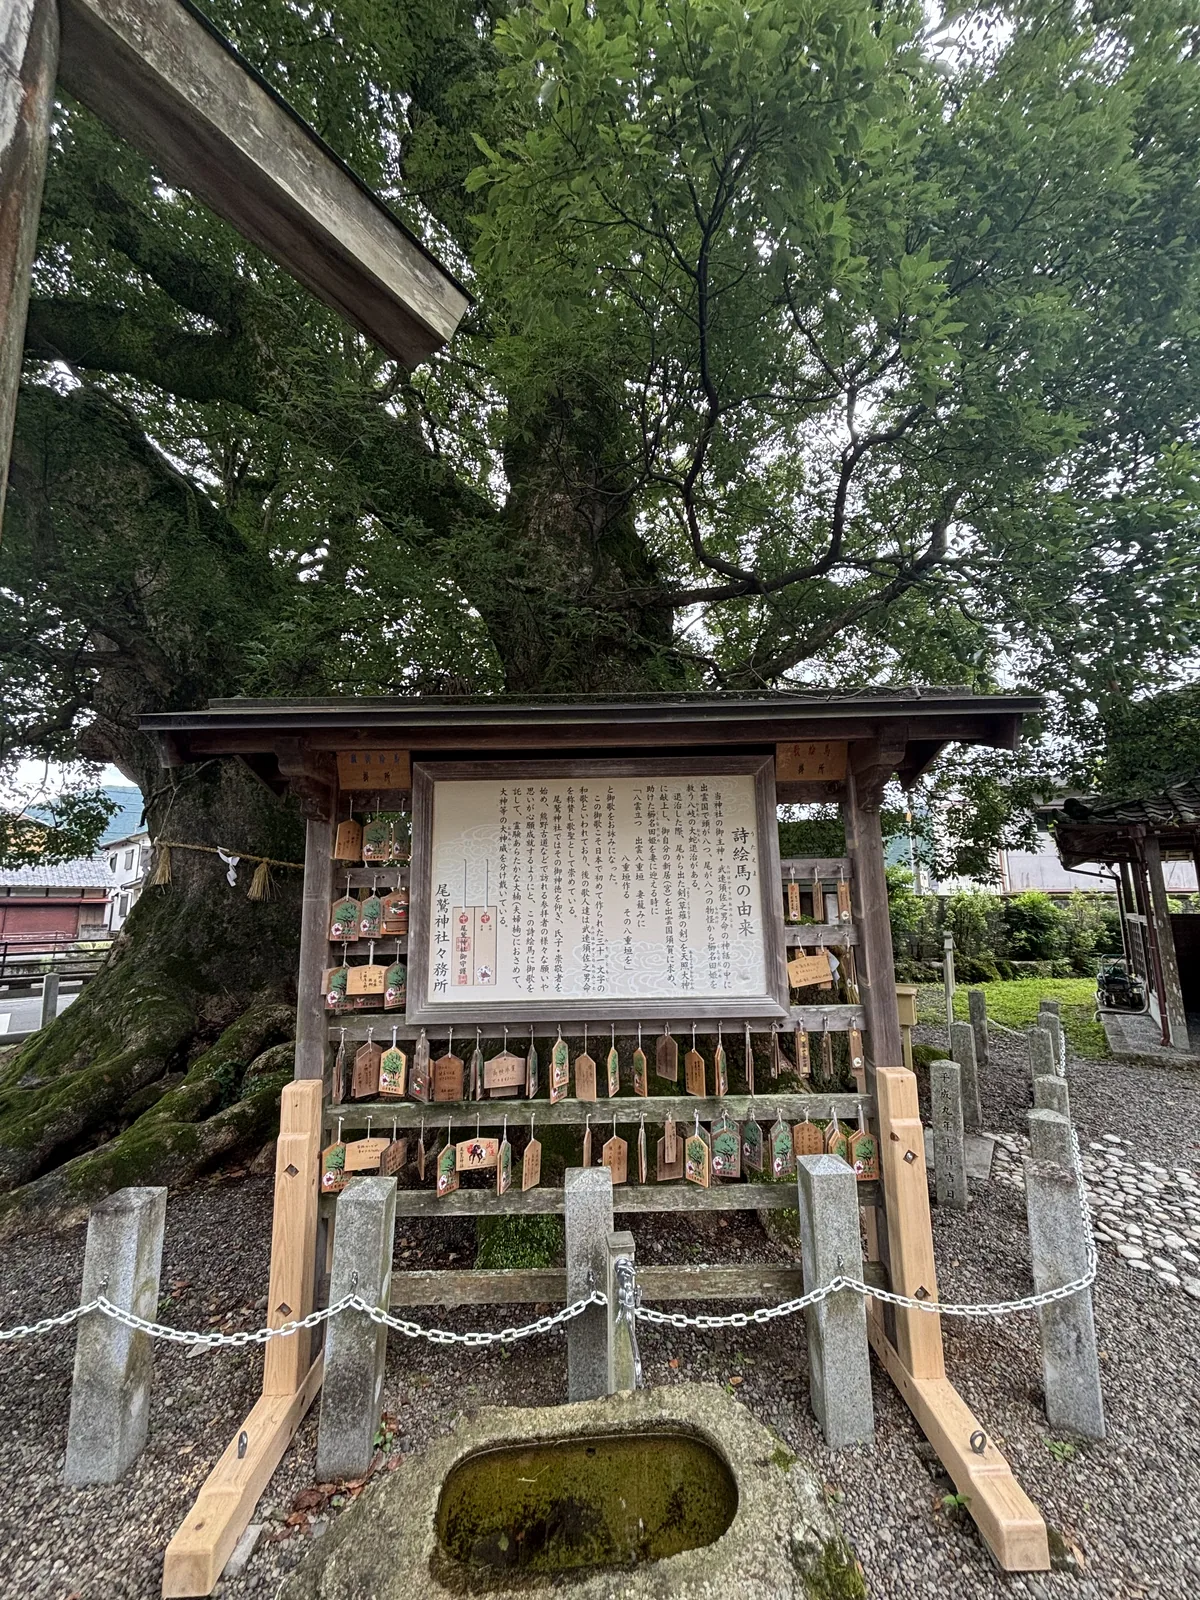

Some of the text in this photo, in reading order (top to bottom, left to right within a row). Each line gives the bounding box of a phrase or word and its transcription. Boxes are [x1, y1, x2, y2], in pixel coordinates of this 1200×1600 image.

[607, 786, 617, 884] と御歌をお詠みになった。
[633, 788, 643, 826] 「八雲立つ
[635, 837, 644, 880] 出雲八重垣
[687, 785, 700, 890] 救う八岐の大蛇退治がある。
[526, 788, 535, 992] 思いが心願成就するようにと、この詩絵馬に御歌を
[540, 788, 549, 991] 始め、熊野古道などで訪れる参拝者の様々な願いや
[594, 796, 607, 991] この御歌こそ日本で初めて作られた三十一文字の
[622, 856, 633, 970] 八重垣作る その八重垣を」
[733, 827, 754, 936] 詩絵馬の由来
[434, 884, 450, 993] 尾鷲神社々務所
[940, 1072, 955, 1200] 平成九年十月吉日
